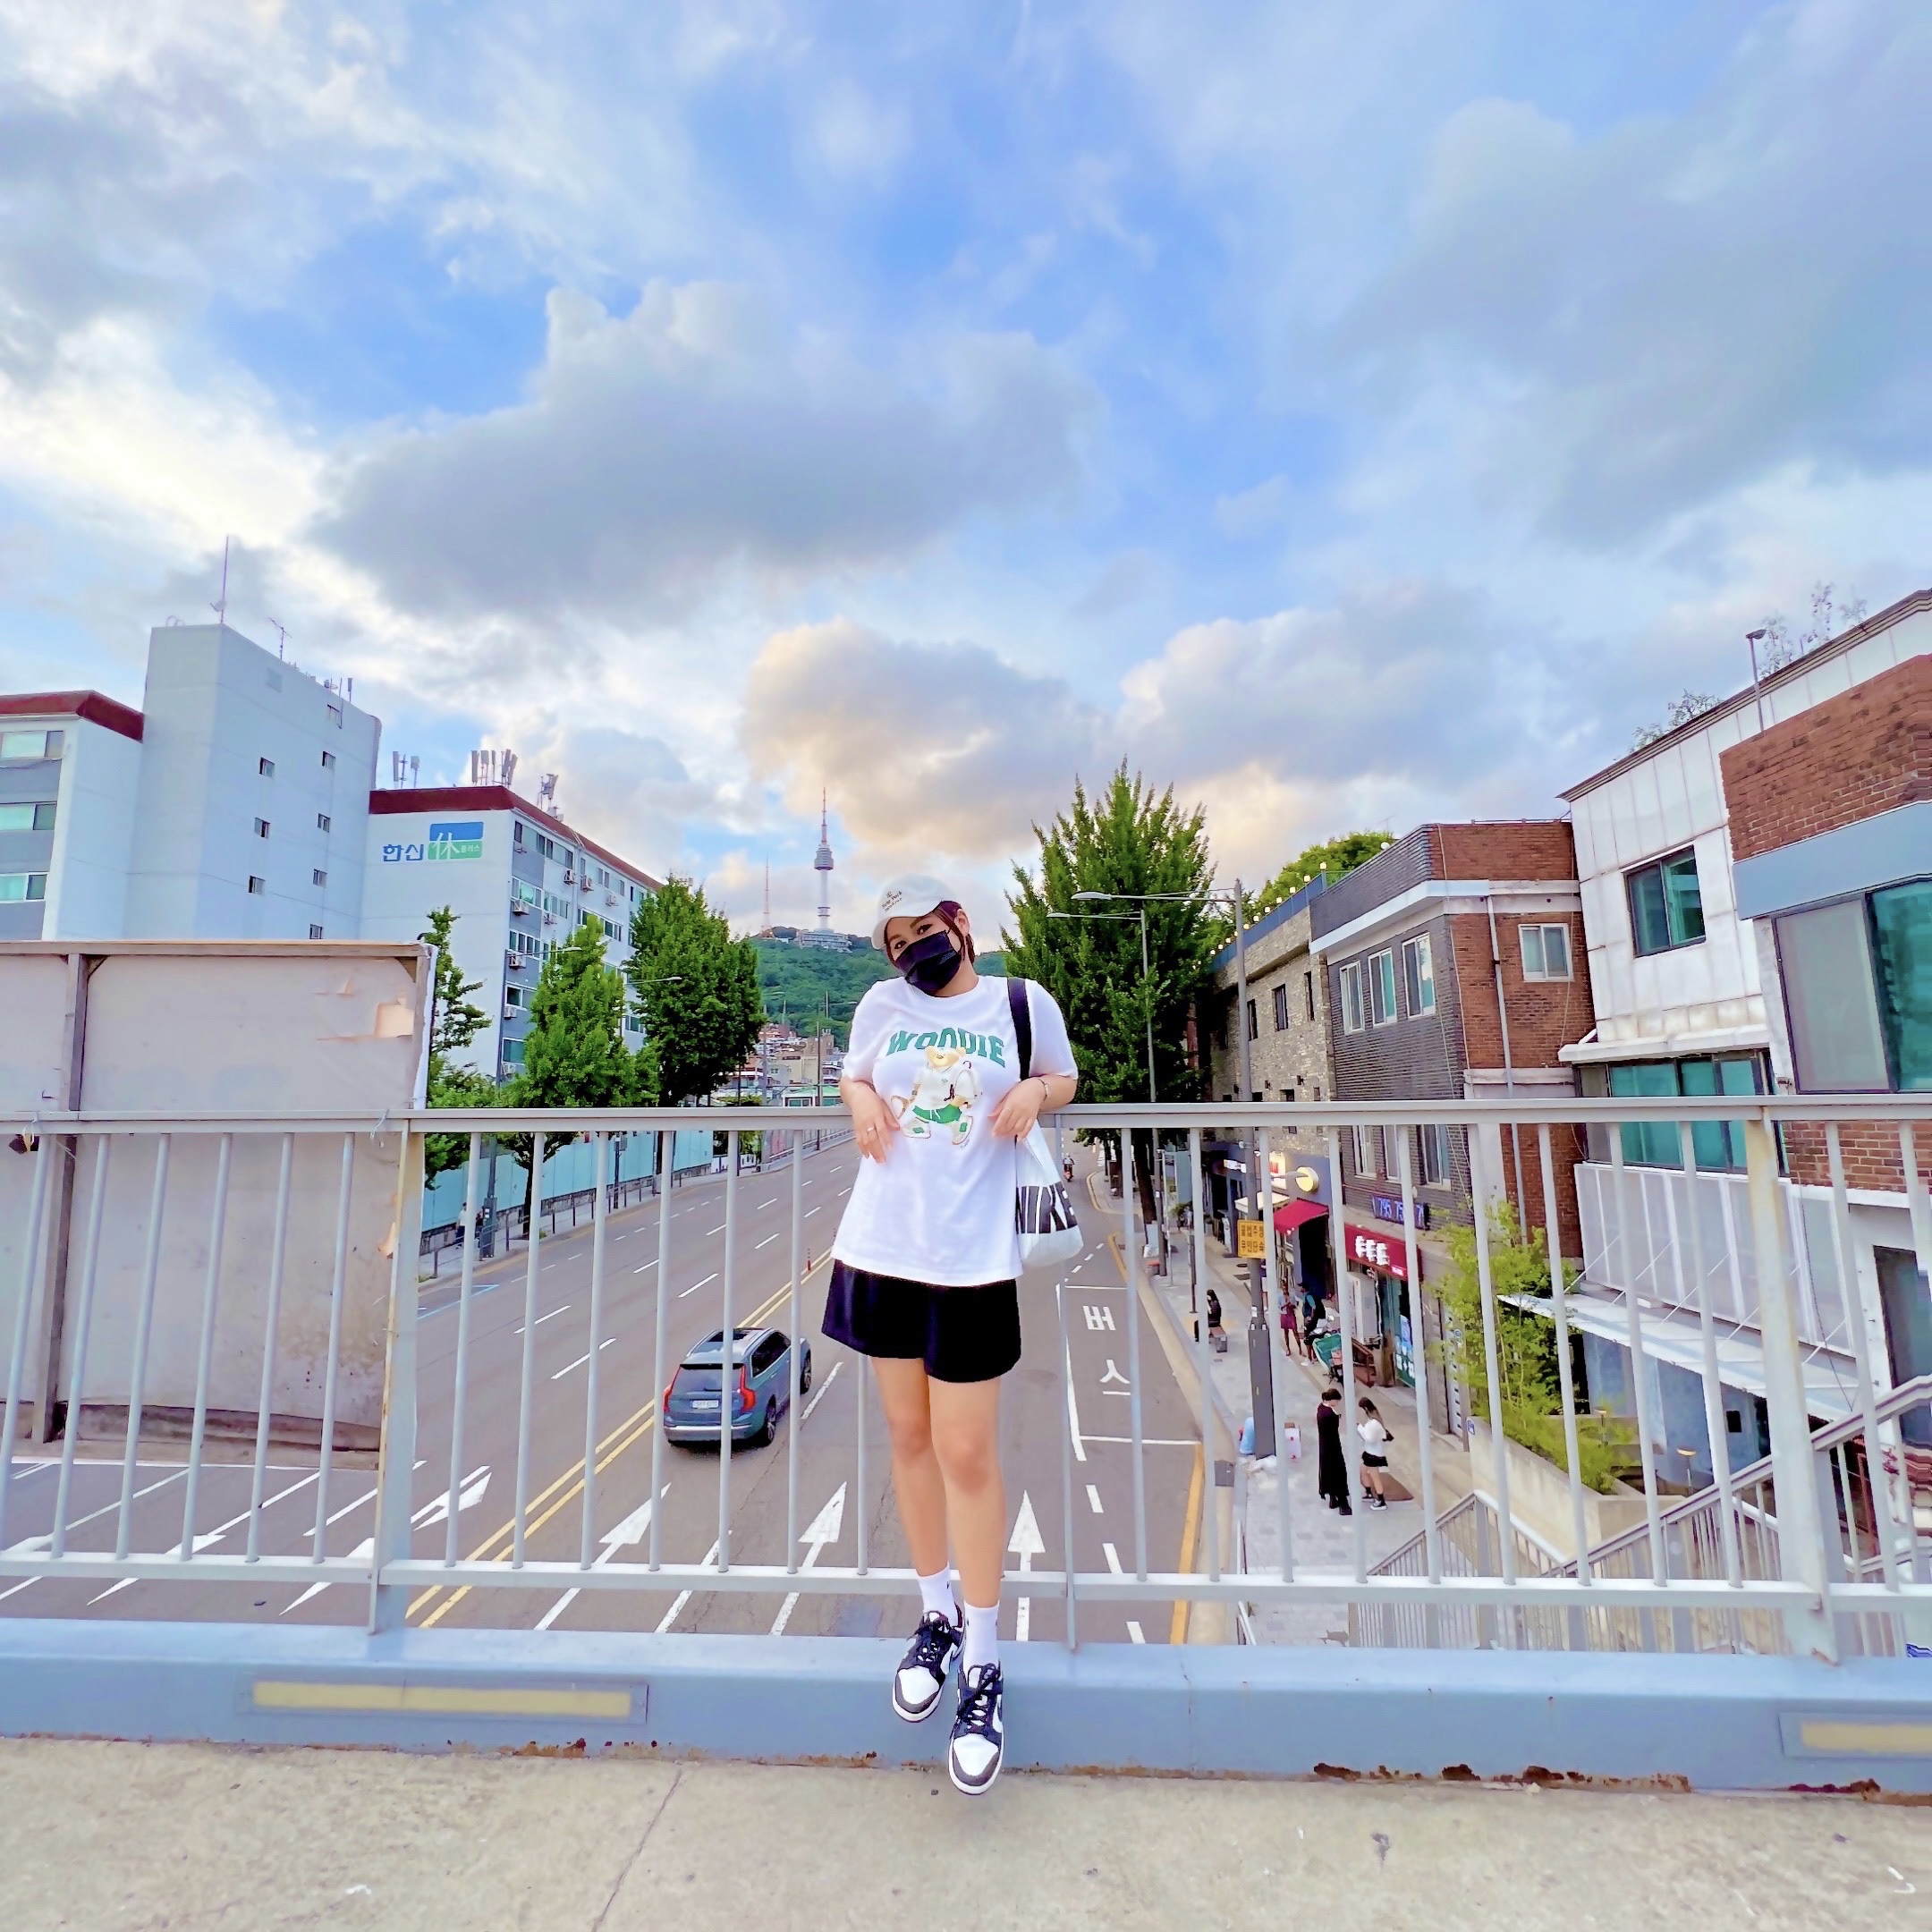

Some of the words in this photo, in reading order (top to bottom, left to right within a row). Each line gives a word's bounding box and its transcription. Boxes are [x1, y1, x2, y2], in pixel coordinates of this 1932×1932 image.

[382, 843, 425, 862] 한신
[432, 832, 461, 860] 休
[1015, 1181, 1078, 1234] NIKE
